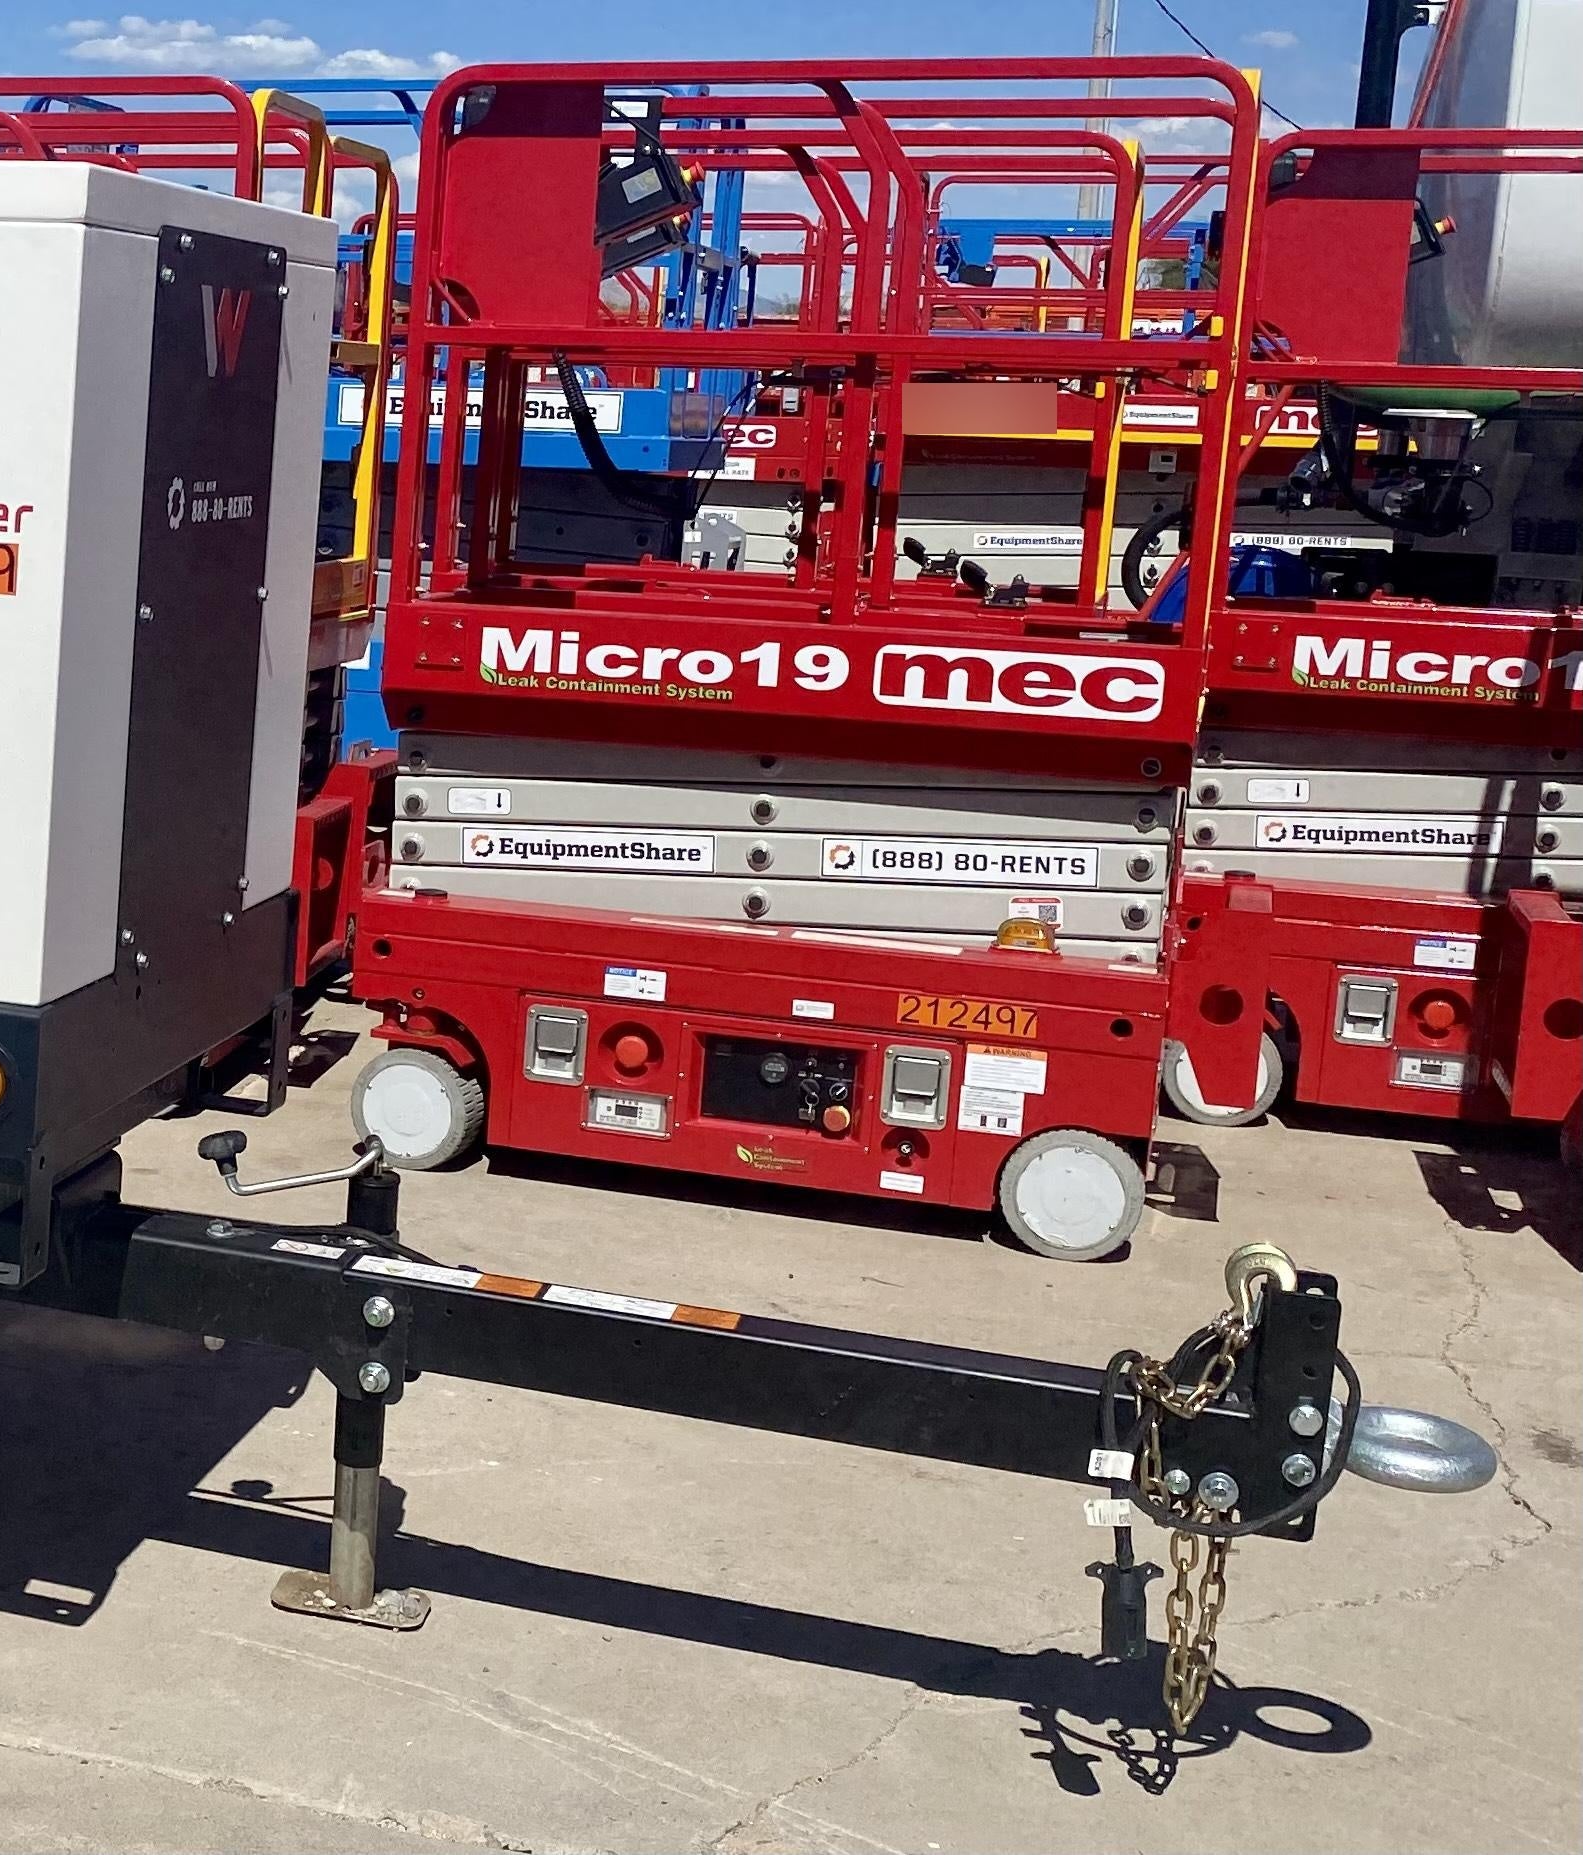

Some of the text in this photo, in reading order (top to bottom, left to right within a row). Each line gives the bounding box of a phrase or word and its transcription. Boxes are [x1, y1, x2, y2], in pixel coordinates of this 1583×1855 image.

[723, 429, 774, 445] ec
[990, 536, 1083, 547] EquipmentShare
[480, 626, 850, 691] Micro19
[498, 674, 734, 702] Leak Containment System
[879, 652, 1160, 713] mec
[1310, 677, 1540, 702] Leak Containment System
[1291, 824, 1491, 847] EquipmentShare
[498, 837, 702, 863] EquipmentShare
[872, 848, 1087, 876] (888) 80-RENTS
[900, 995, 1040, 1037] 212497
[992, 1047, 1032, 1058] WARNING
